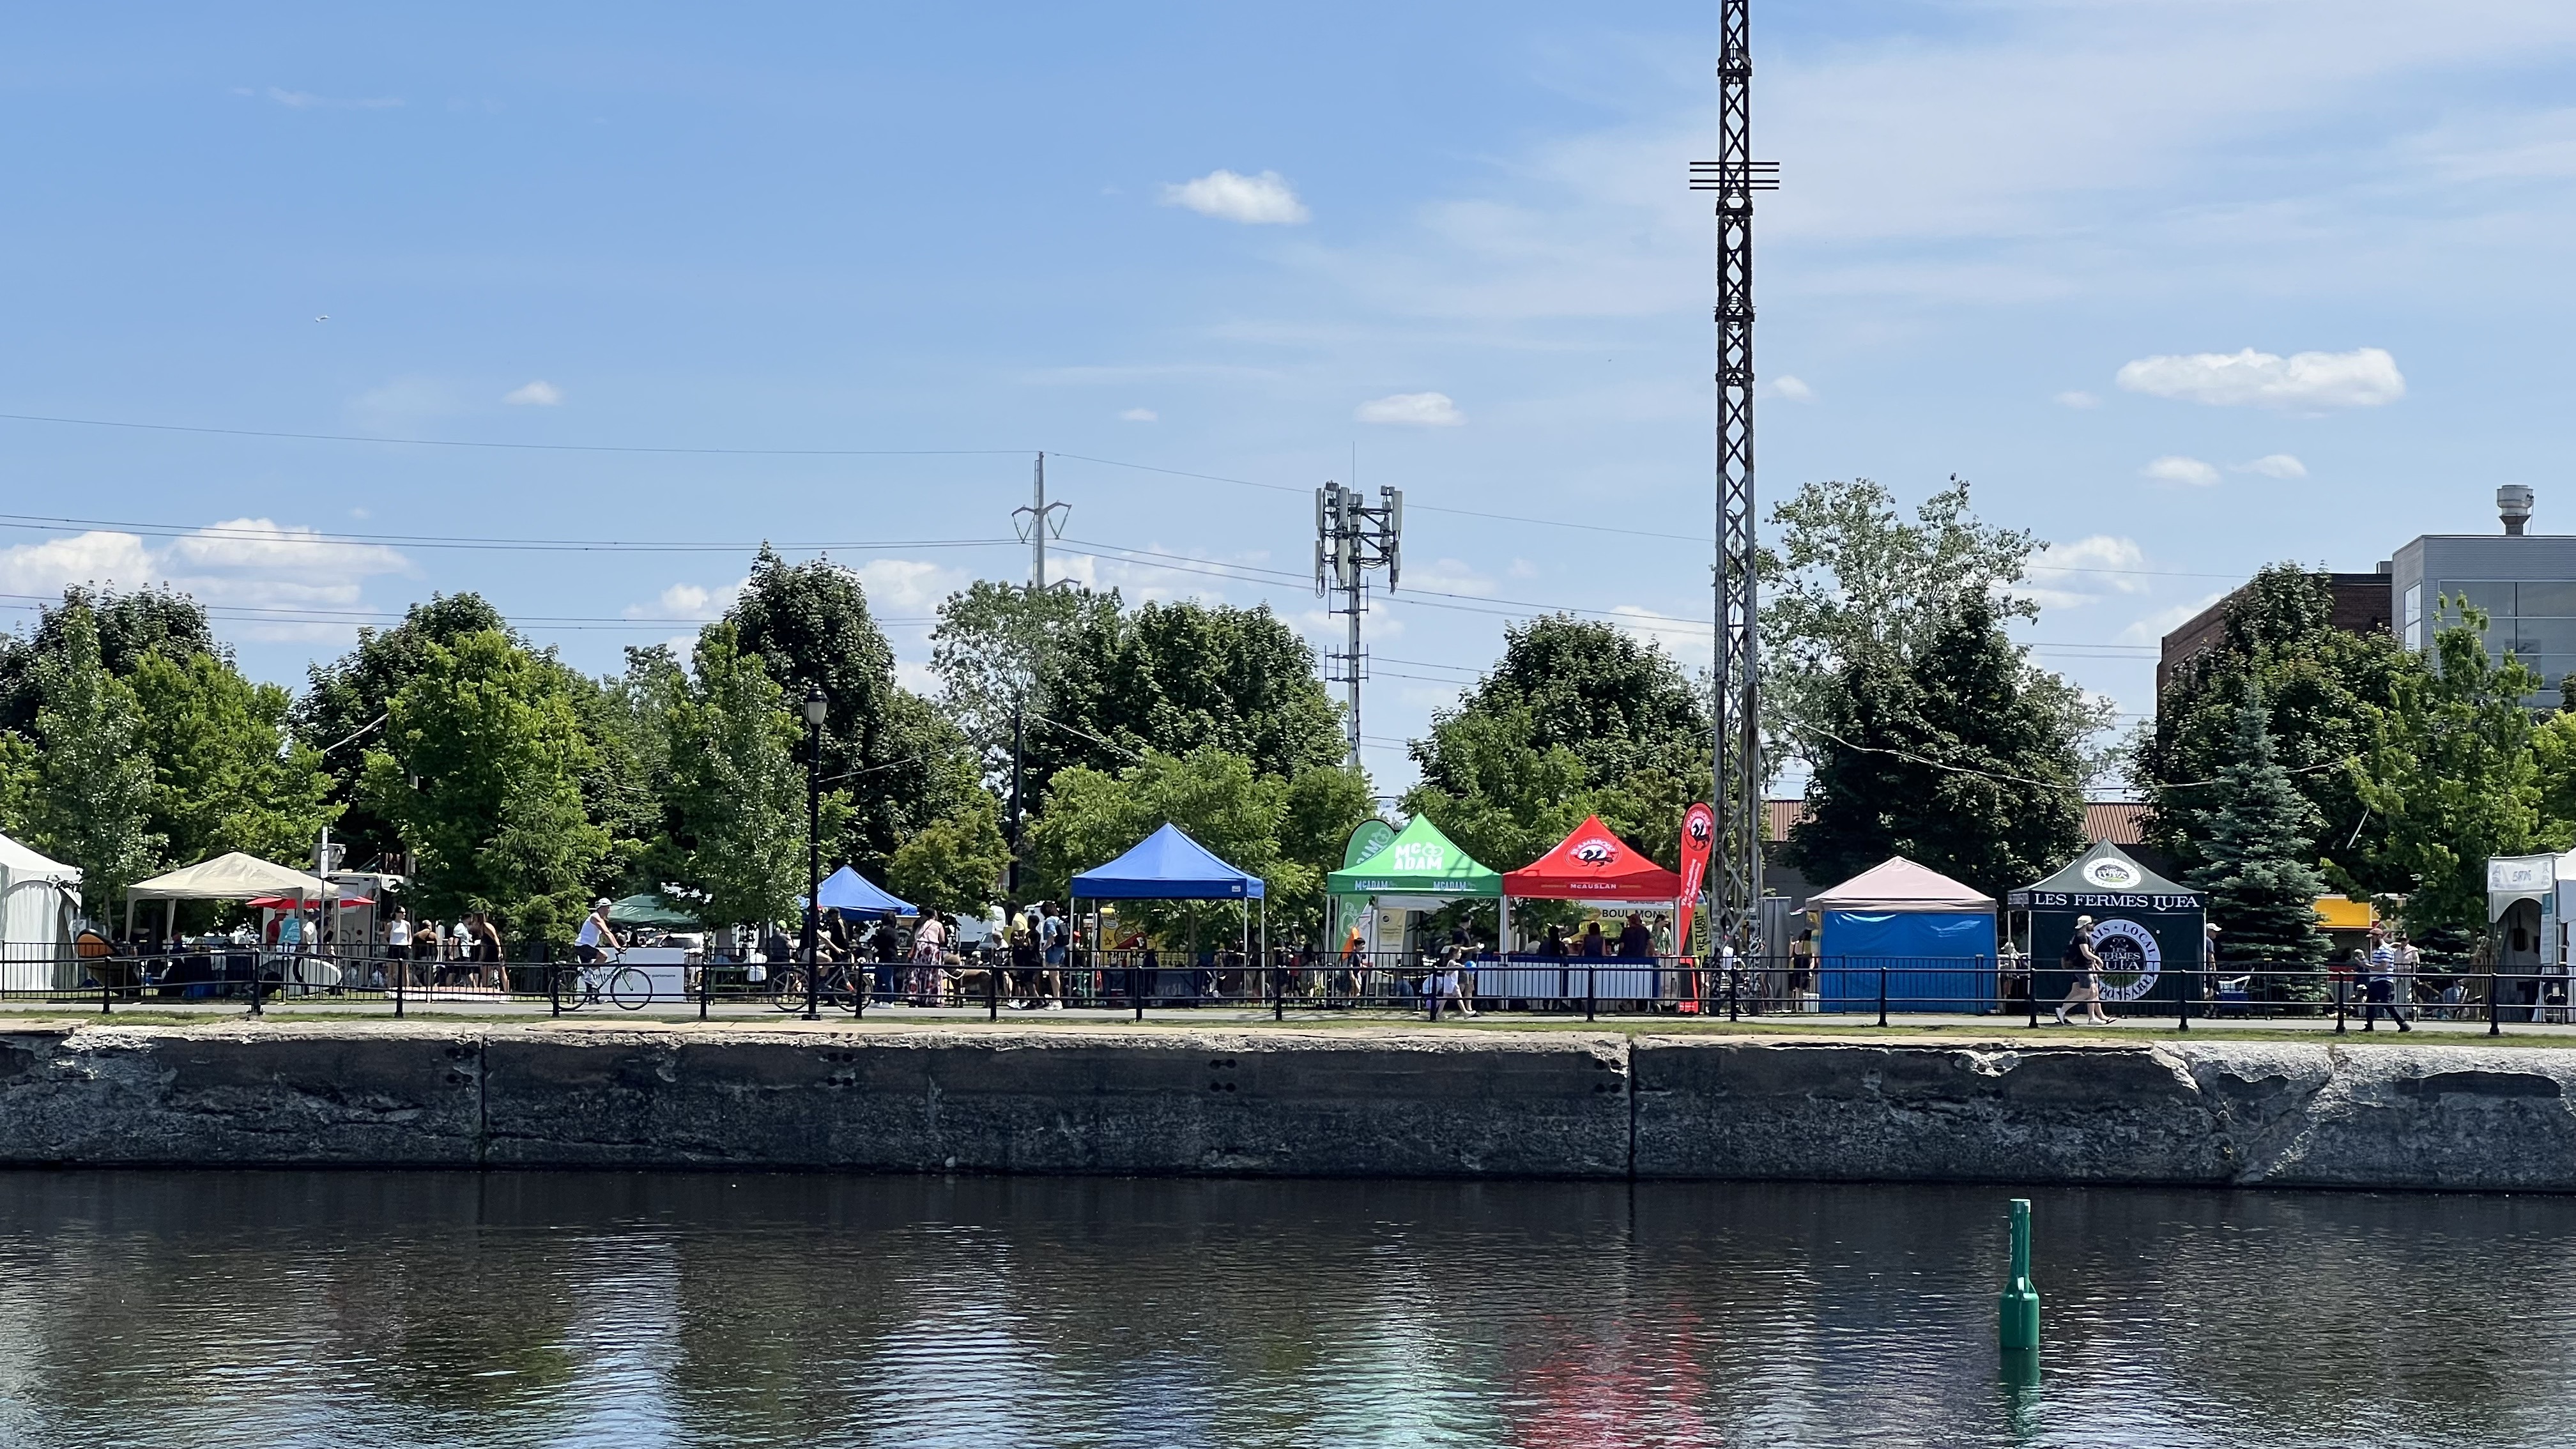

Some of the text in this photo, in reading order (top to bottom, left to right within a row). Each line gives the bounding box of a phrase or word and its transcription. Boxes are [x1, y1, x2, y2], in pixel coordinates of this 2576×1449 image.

[1393, 856, 1443, 870] ADAM
[2034, 893, 2067, 906] LES
[2074, 894, 2149, 907] FERMES
[2153, 895, 2200, 911] LUFA
[1602, 909, 1628, 917] BOUL
[2091, 923, 2156, 956] AIS LOCAL
[2098, 952, 2141, 960] FERMES
[2106, 959, 2140, 970] UFA
